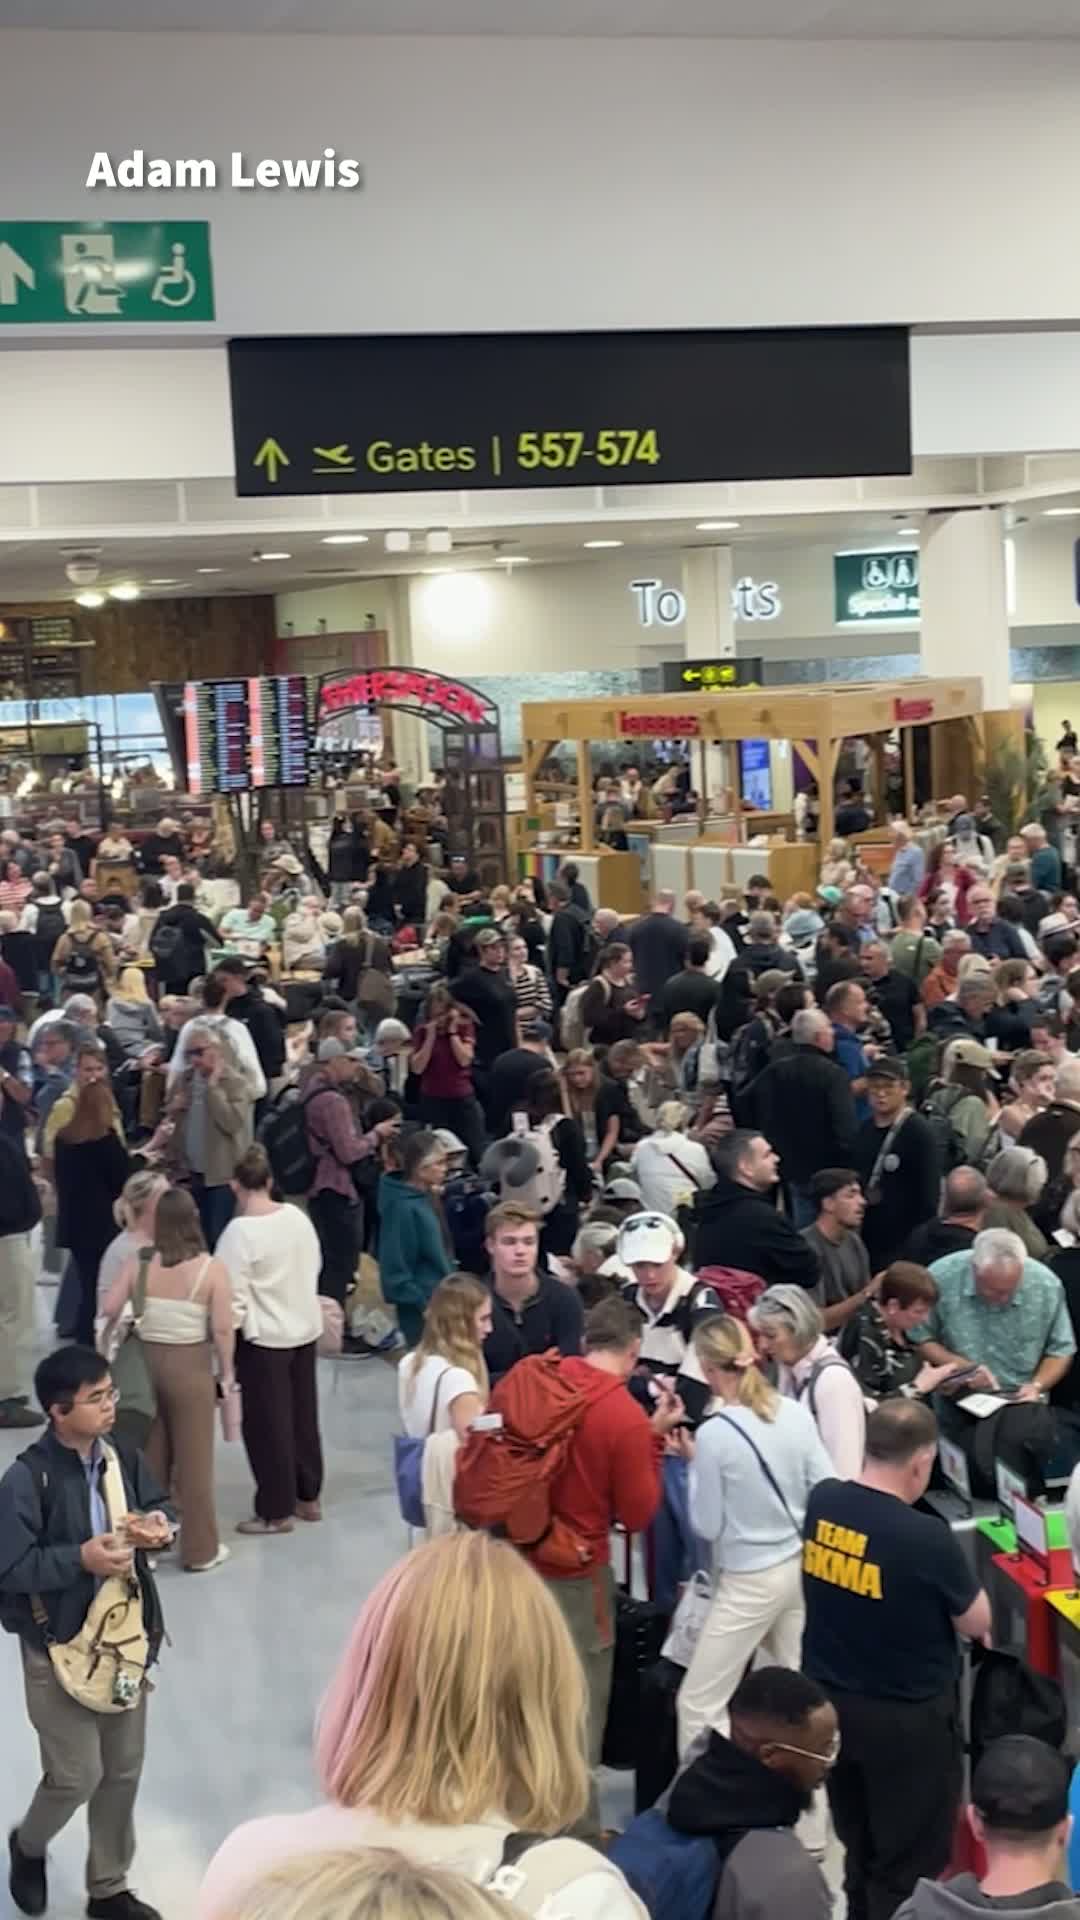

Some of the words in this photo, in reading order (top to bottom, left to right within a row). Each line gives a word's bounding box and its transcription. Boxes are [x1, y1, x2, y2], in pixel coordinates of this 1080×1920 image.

[366, 440, 477, 473] Gates
[516, 429, 661, 469] 557-574
[630, 578, 780, 626] Tots
[816, 1519, 869, 1558] TEAM
